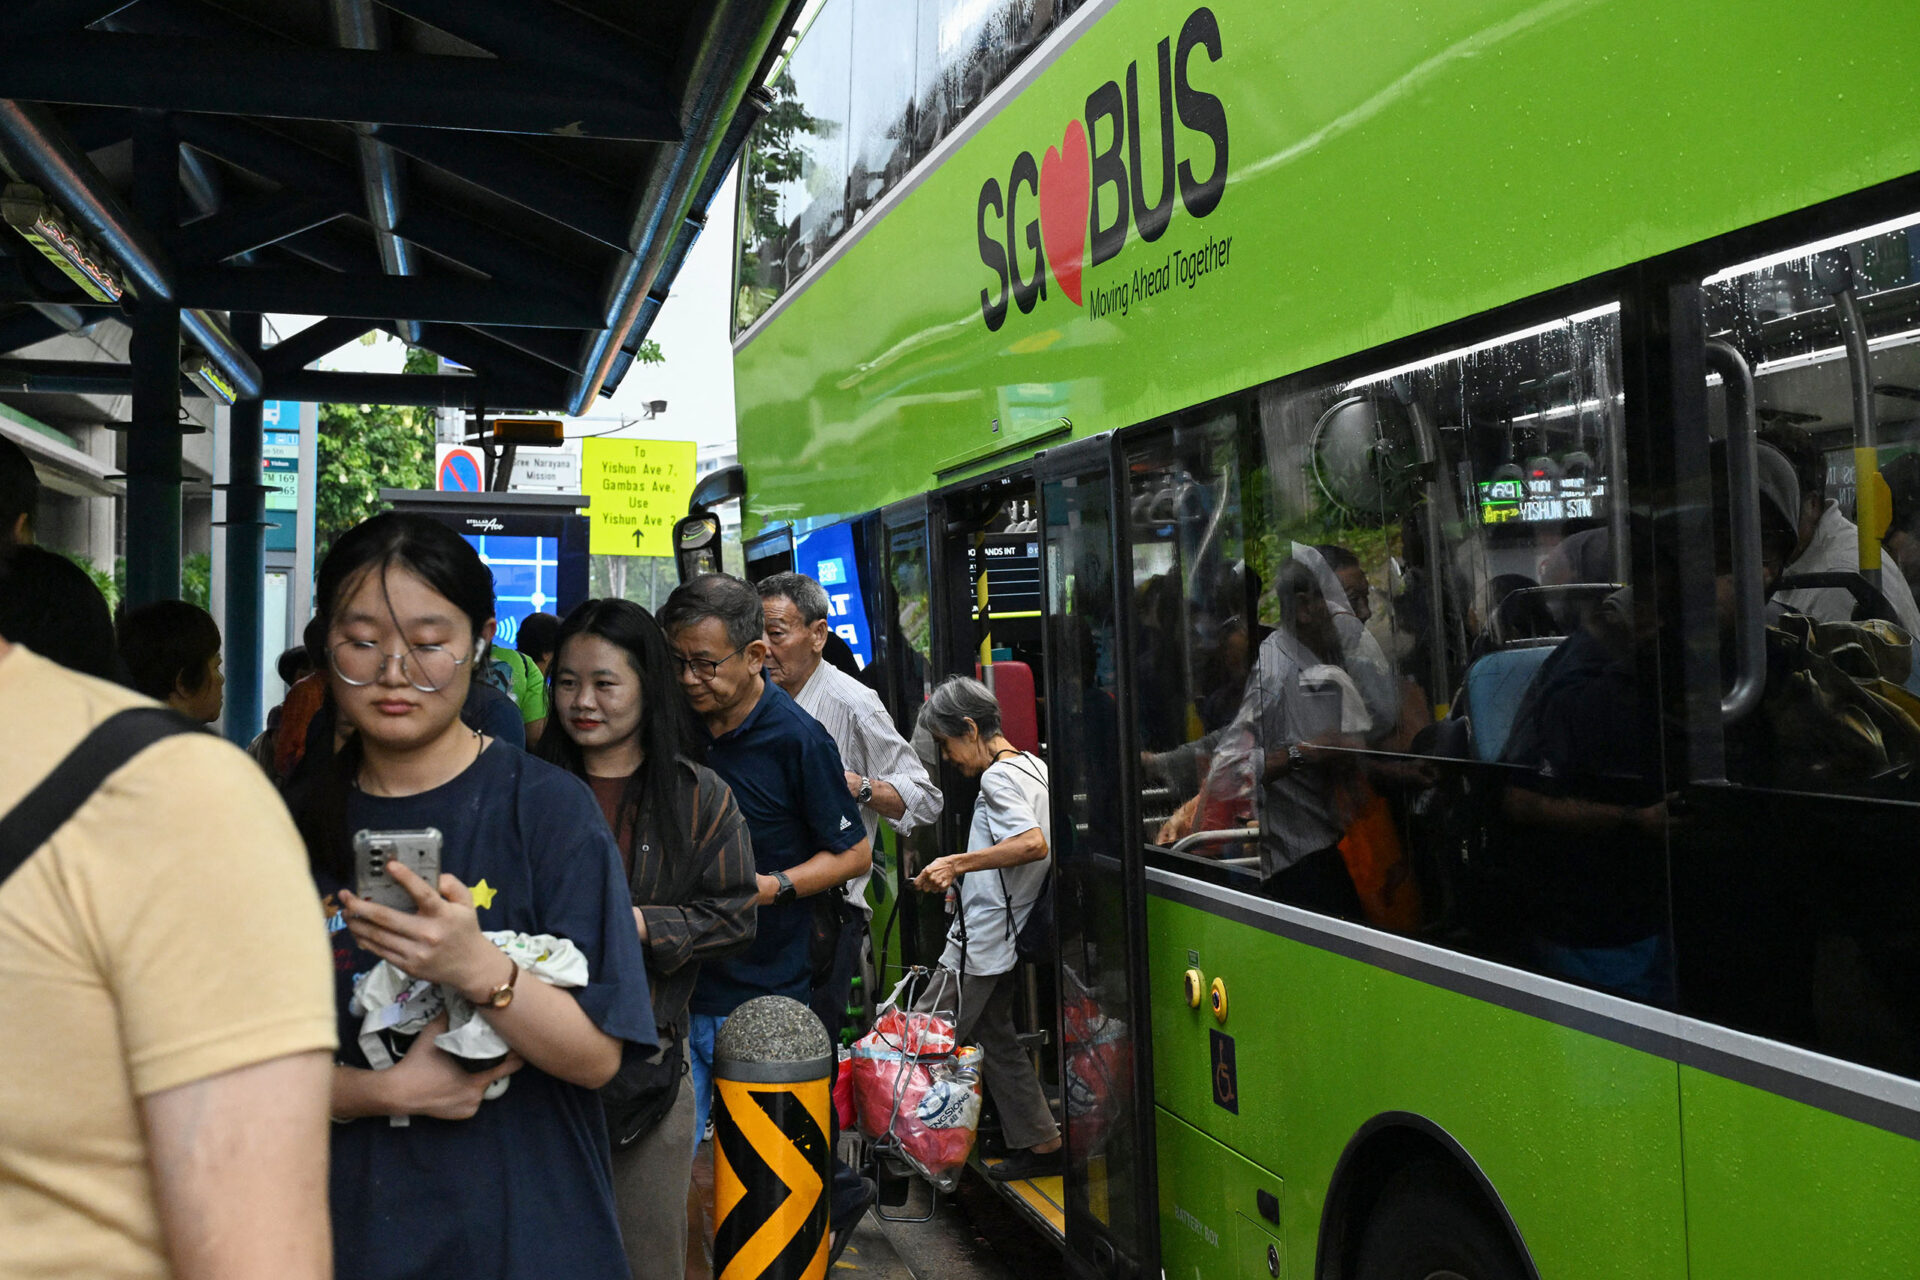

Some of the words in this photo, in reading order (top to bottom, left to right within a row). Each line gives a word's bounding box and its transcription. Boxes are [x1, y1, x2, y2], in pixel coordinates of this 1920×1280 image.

[1090, 281, 1129, 322] Moving
[1131, 255, 1170, 305] Ahead
[1173, 235, 1233, 289] Together
[635, 446, 646, 458] To
[534, 458, 570, 470] Narayana
[602, 461, 637, 474] Yishun
[643, 463, 662, 475] Ave
[279, 474, 295, 483] 169
[527, 471, 557, 481] Mission
[603, 479, 645, 492] Gambas
[629, 497, 649, 508] Use
[1520, 499, 1564, 521] YISHUN
[1566, 498, 1593, 519] STN
[602, 512, 637, 525] Yishun
[644, 515, 662, 526] Ave
[1004, 547, 1016, 556] INT
[1205, 1226, 1219, 1248] BOX
